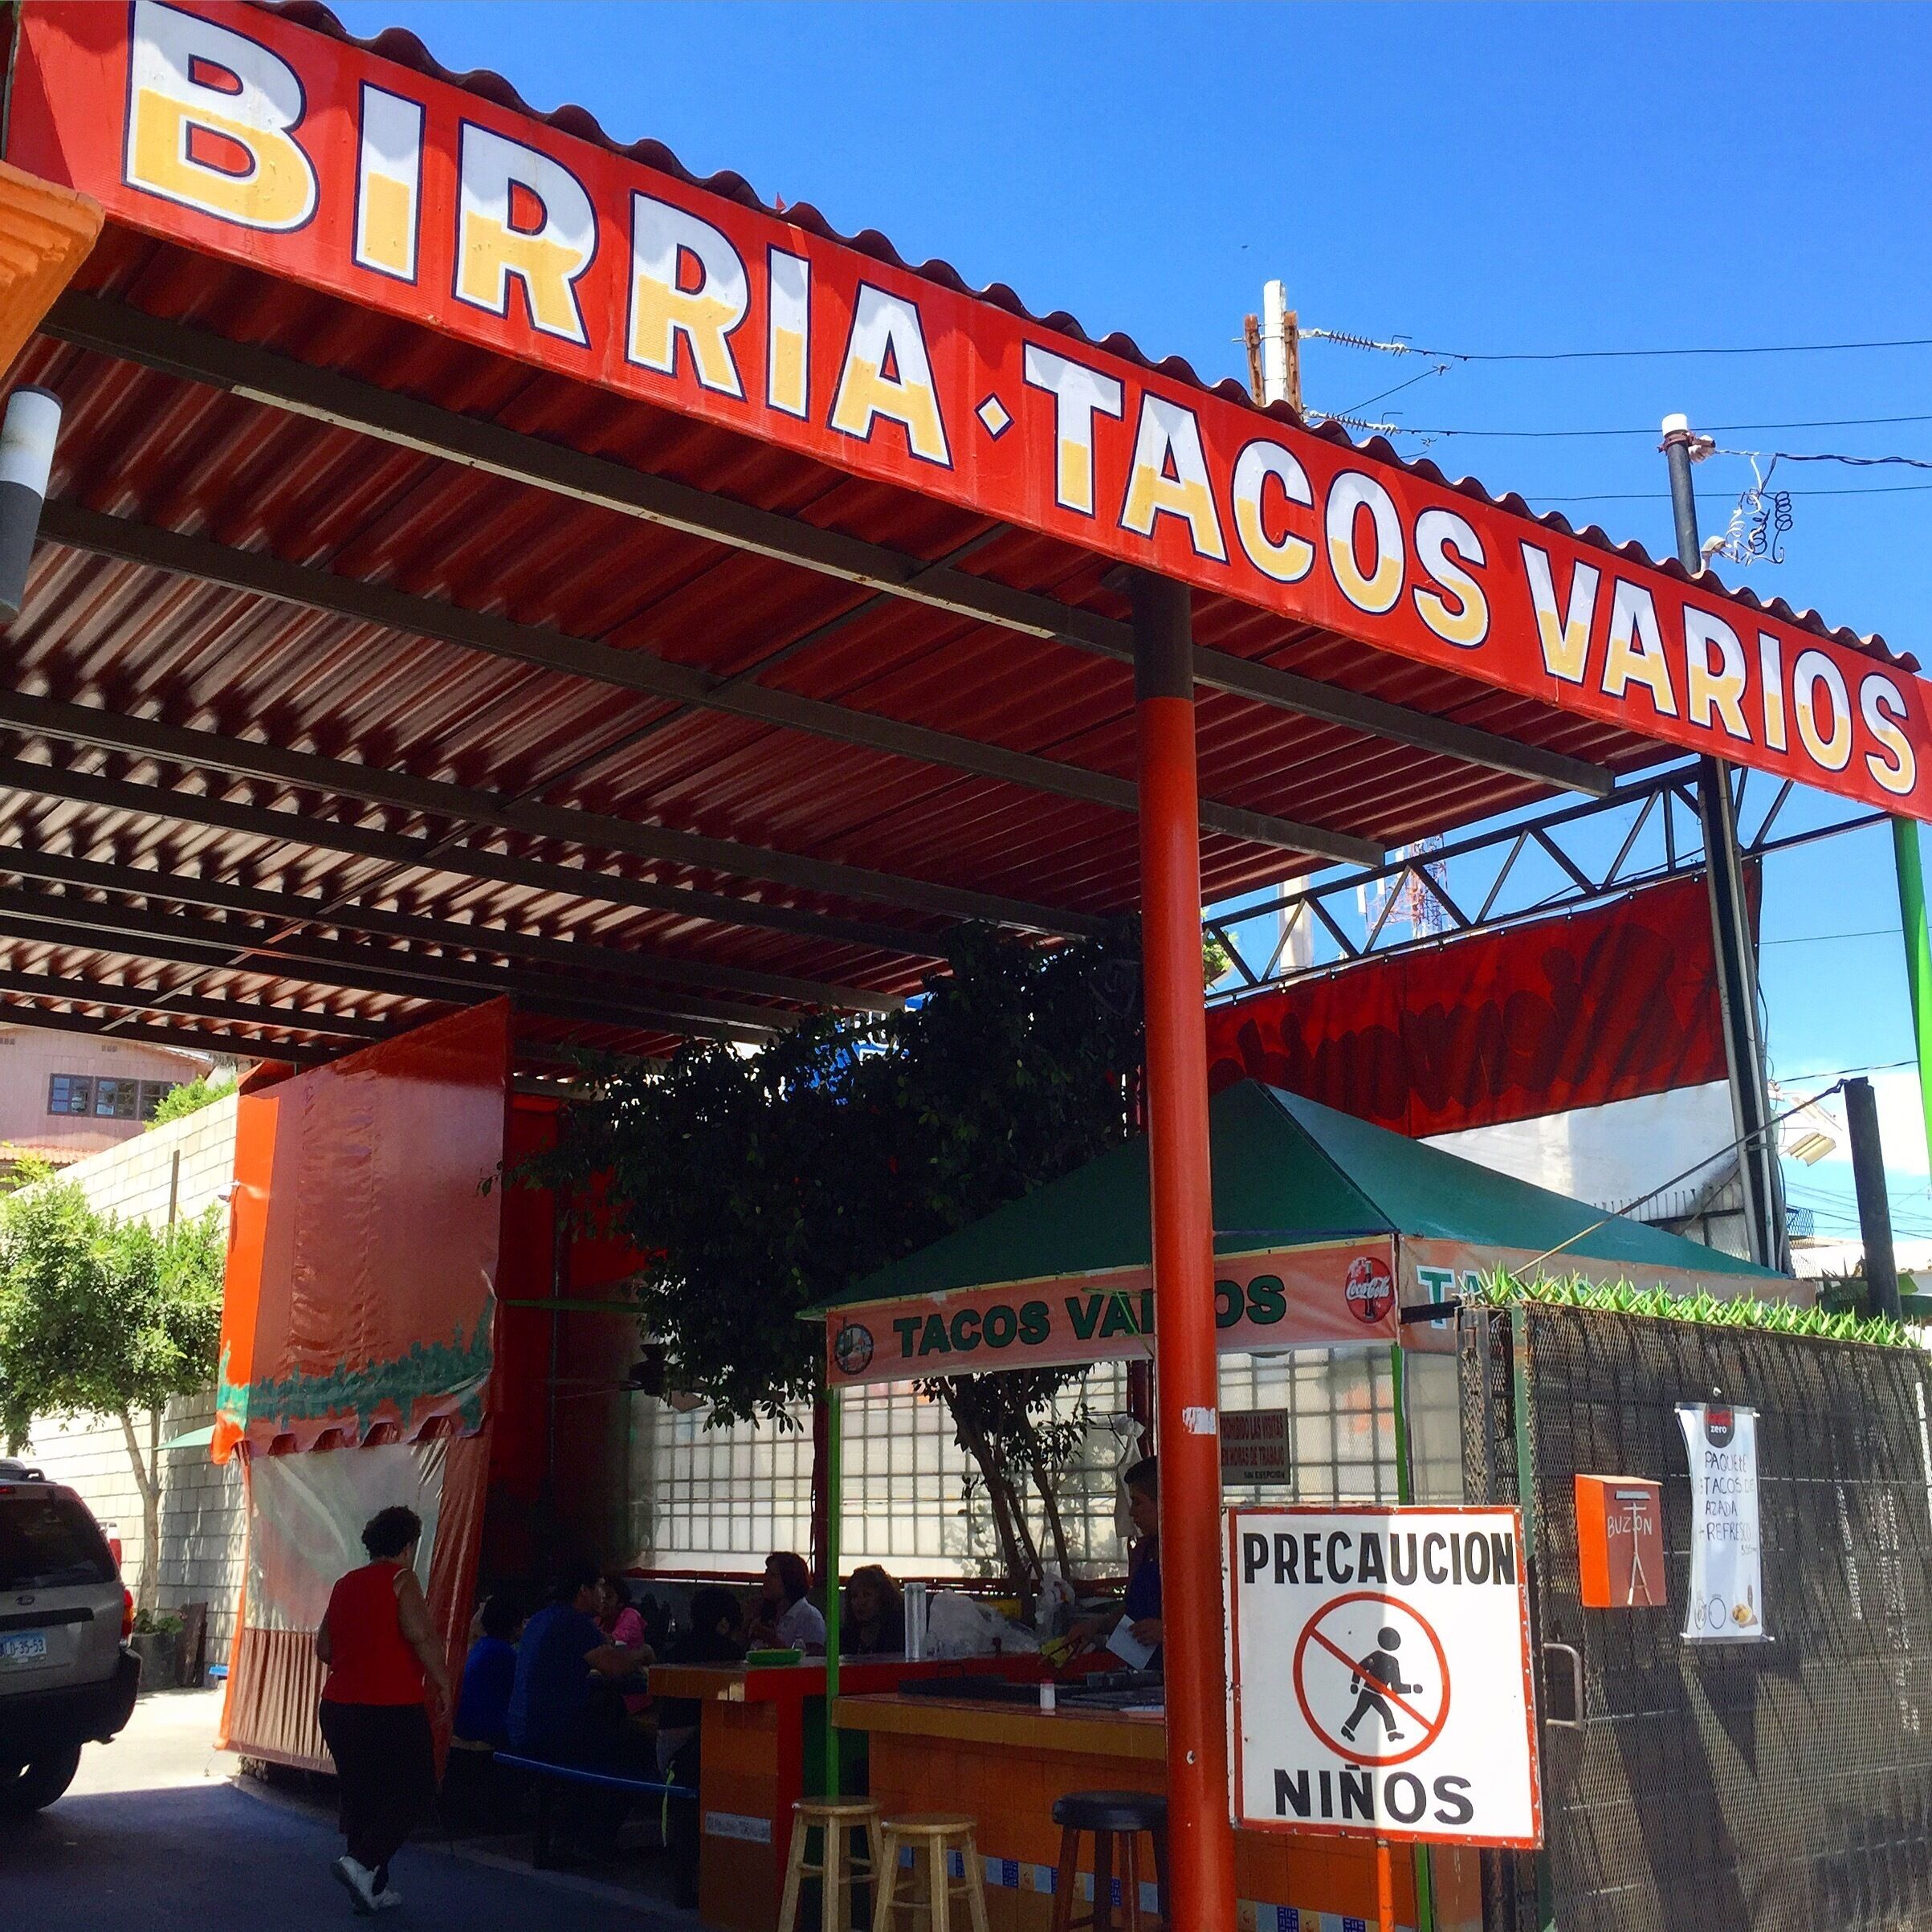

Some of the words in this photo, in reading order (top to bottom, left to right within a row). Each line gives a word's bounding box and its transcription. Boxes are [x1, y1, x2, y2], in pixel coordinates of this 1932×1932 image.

[121, 0, 954, 471] BIRRIA
[1022, 340, 1489, 650] TACOS
[1520, 538, 1918, 797] VARIOS
[1346, 1275, 1391, 1301] Coca-Cola
[893, 1300, 1050, 1358] TACOS
[1065, 1274, 1286, 1340] VAOS
[1710, 1425, 1727, 1434] zero
[1704, 1476, 1742, 1495] TACOS
[1607, 1515, 1653, 1539] BUZON
[1243, 1531, 1516, 1587] PRECAUCION
[1274, 1764, 1474, 1826] NIÑOS
